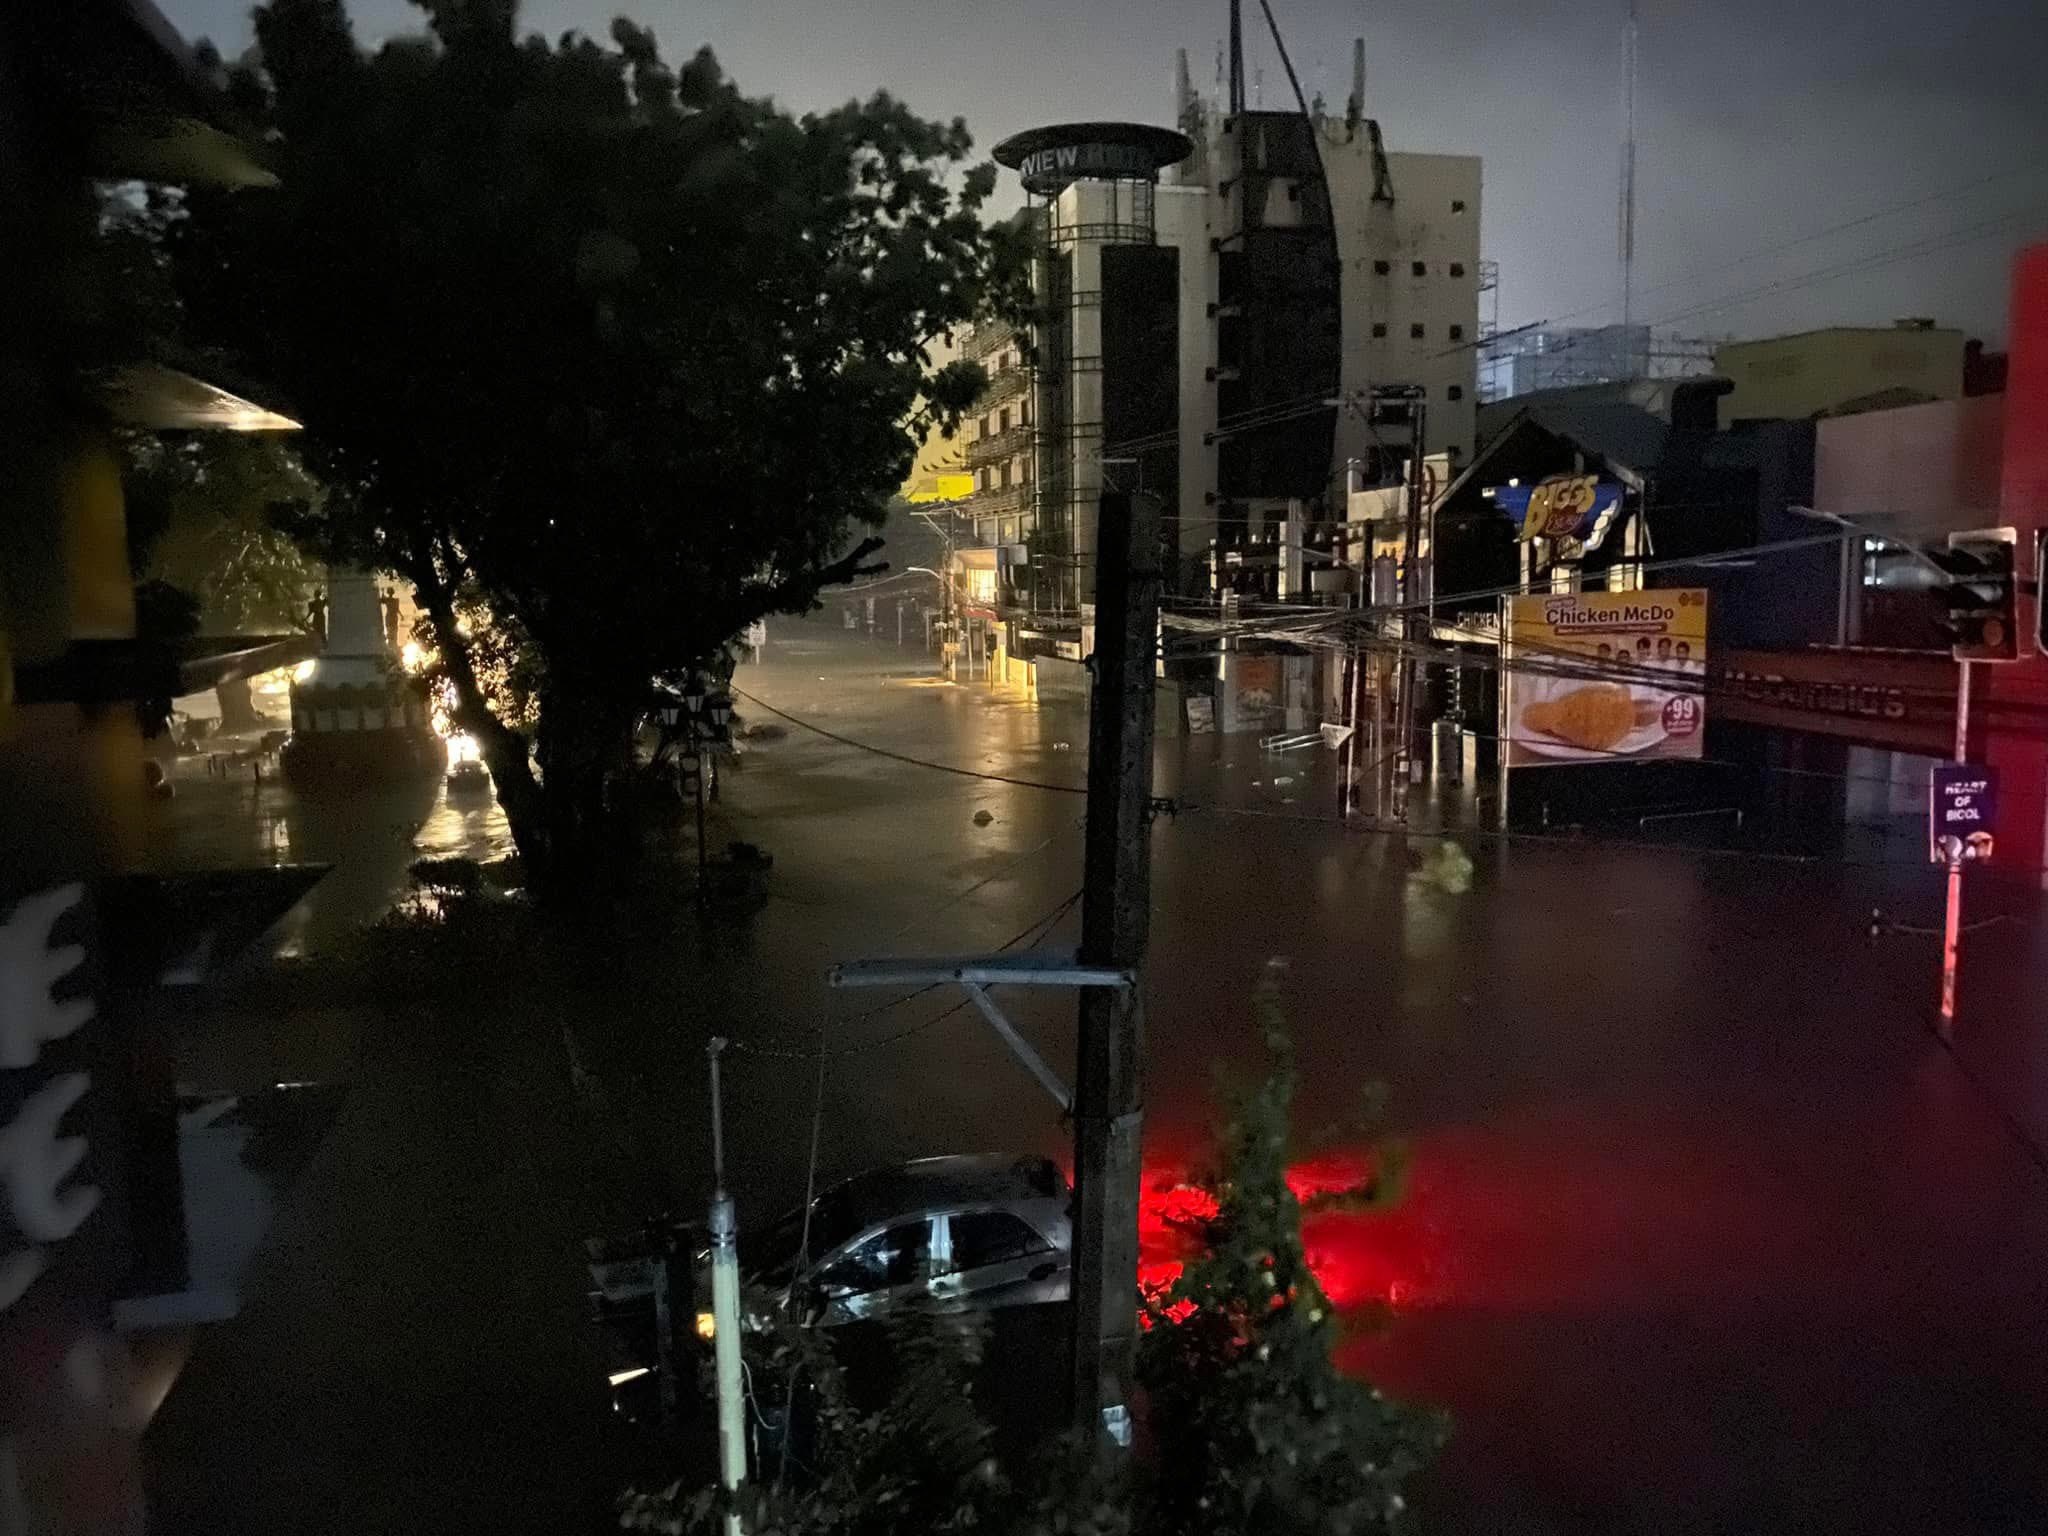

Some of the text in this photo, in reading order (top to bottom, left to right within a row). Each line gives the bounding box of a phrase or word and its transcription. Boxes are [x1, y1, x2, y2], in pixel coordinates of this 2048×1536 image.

[1021, 146, 1078, 176] VIEW
[1457, 611, 1500, 629] CHICKEN
[1546, 605, 1674, 624] Chicken McDo
[1945, 781, 1987, 794] HEART
[1954, 795, 1972, 808] OF
[1946, 808, 1981, 822] BICOL
